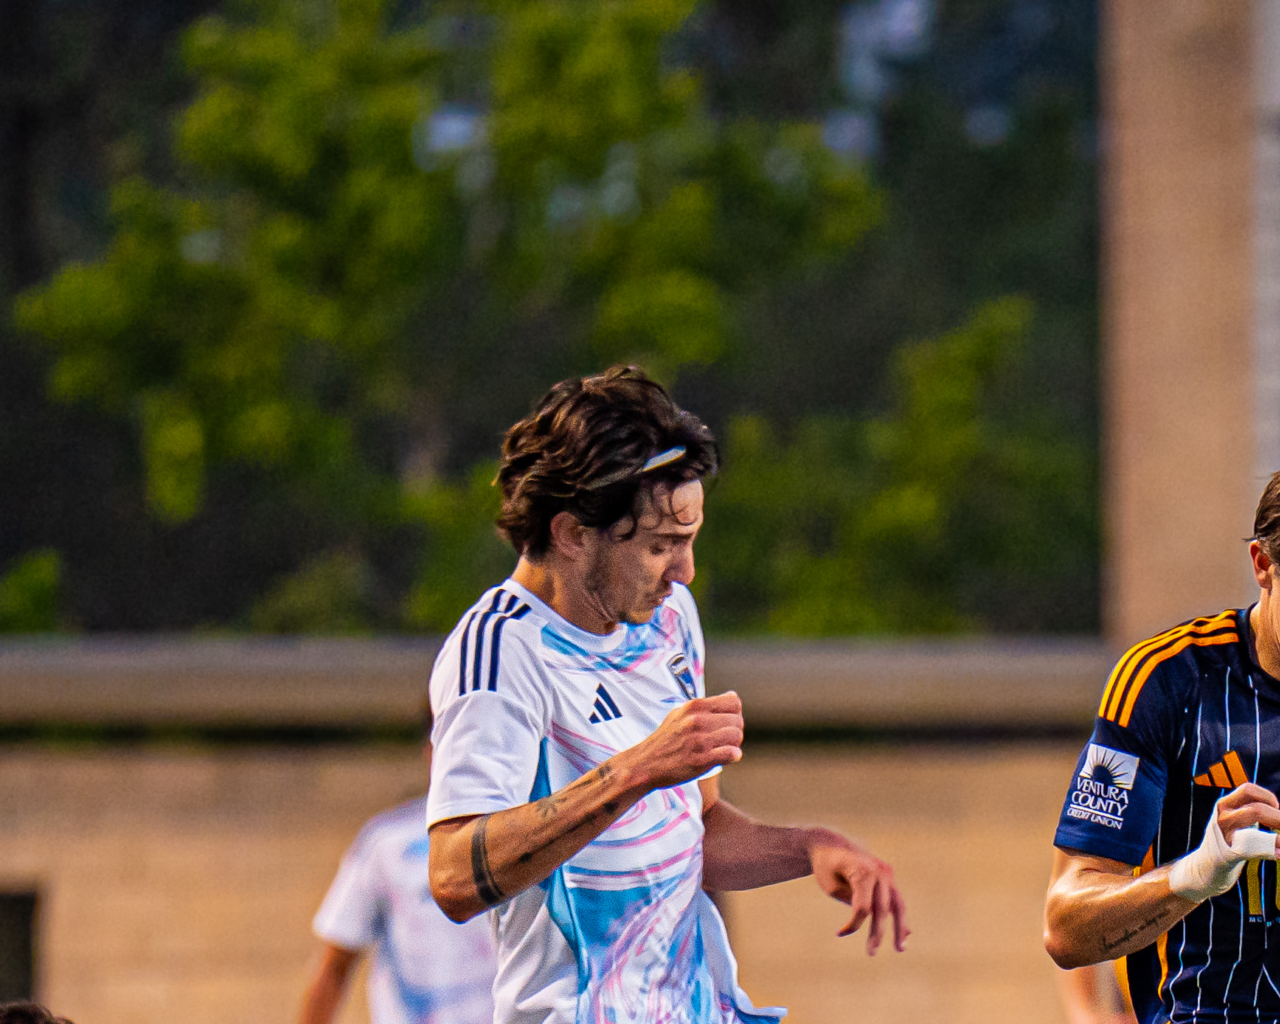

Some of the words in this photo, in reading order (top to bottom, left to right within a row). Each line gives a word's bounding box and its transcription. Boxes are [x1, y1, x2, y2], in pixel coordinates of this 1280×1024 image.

[1071, 790, 1128, 816] COUNTY
[1077, 777, 1129, 804] VENTURA
[1066, 807, 1091, 820] CREDIT
[1090, 814, 1123, 830] UNION
